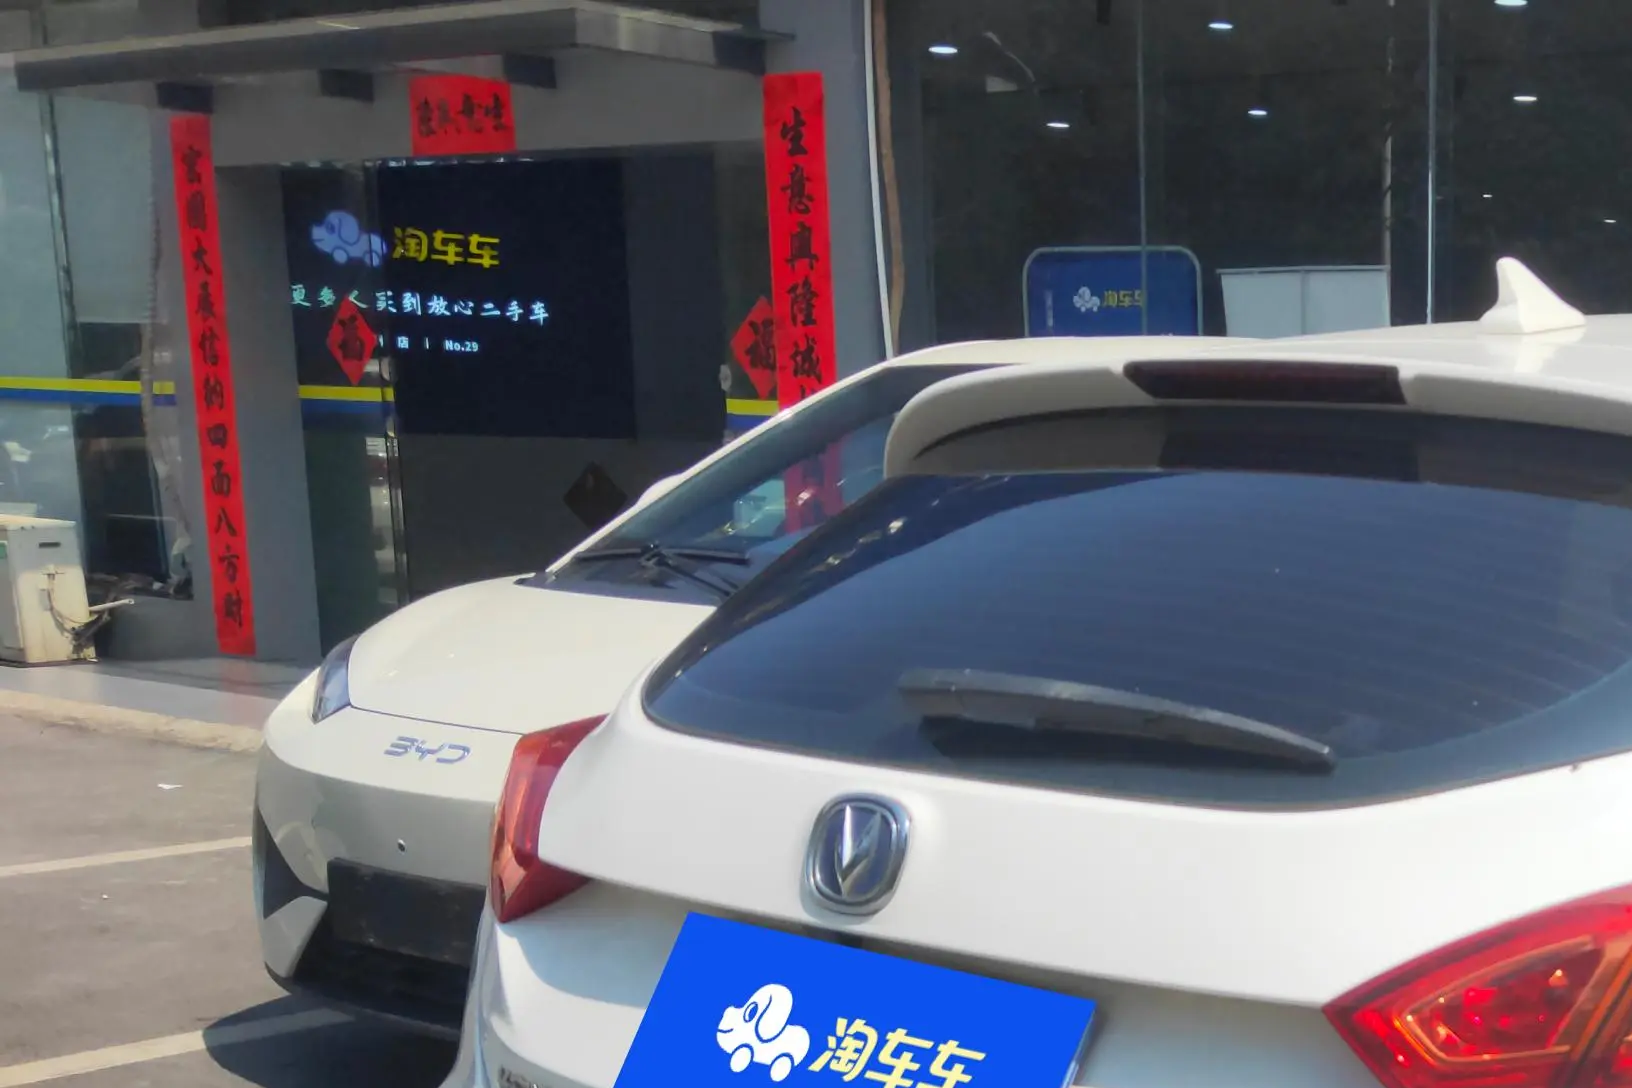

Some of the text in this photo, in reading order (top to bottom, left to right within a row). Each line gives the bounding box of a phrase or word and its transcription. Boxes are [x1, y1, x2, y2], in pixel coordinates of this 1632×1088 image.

[392, 227, 500, 269] 淘车车
[445, 339, 479, 352] No.29
[383, 736, 471, 764] BYD
